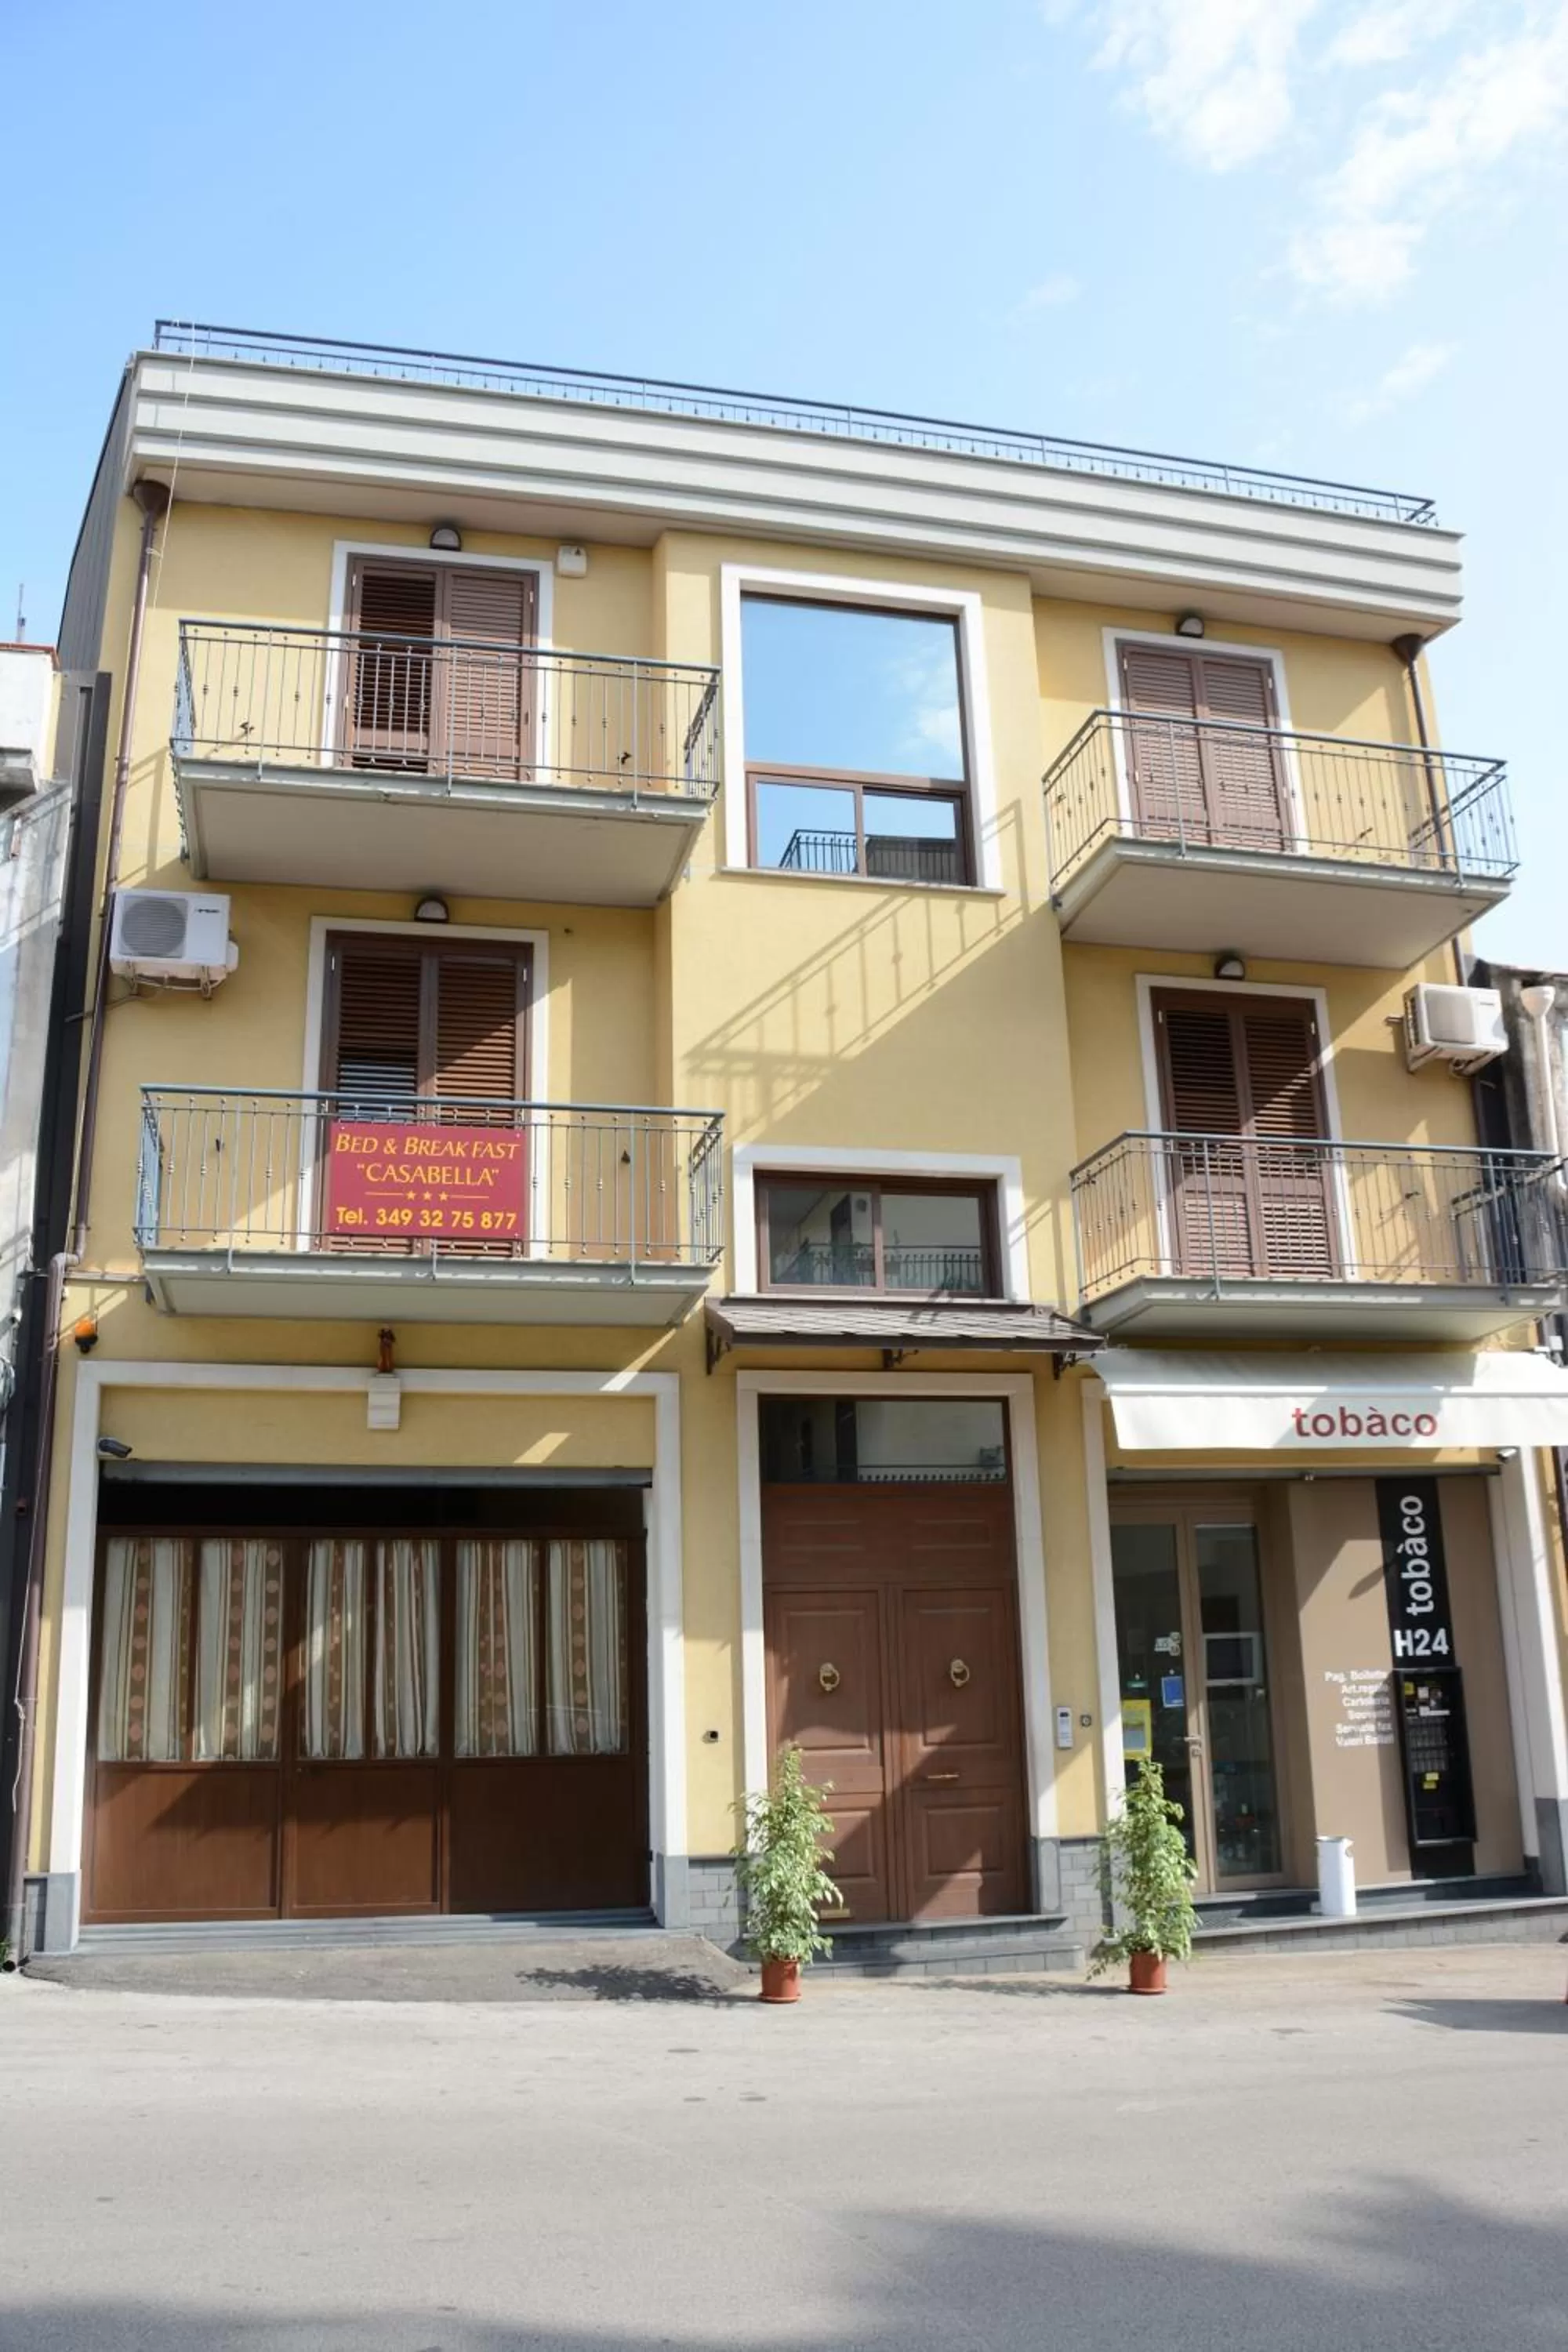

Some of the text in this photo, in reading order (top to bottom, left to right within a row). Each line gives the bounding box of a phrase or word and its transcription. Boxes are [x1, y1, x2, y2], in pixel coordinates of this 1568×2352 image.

[336, 1133, 378, 1154] BED
[383, 1138, 397, 1155] &
[336, 1207, 517, 1230] Tel. 349 32 75 877
[1292, 1406, 1438, 1437] tobàco
[1396, 1495, 1434, 1616] tobàco
[1394, 1628, 1449, 1657] H24
